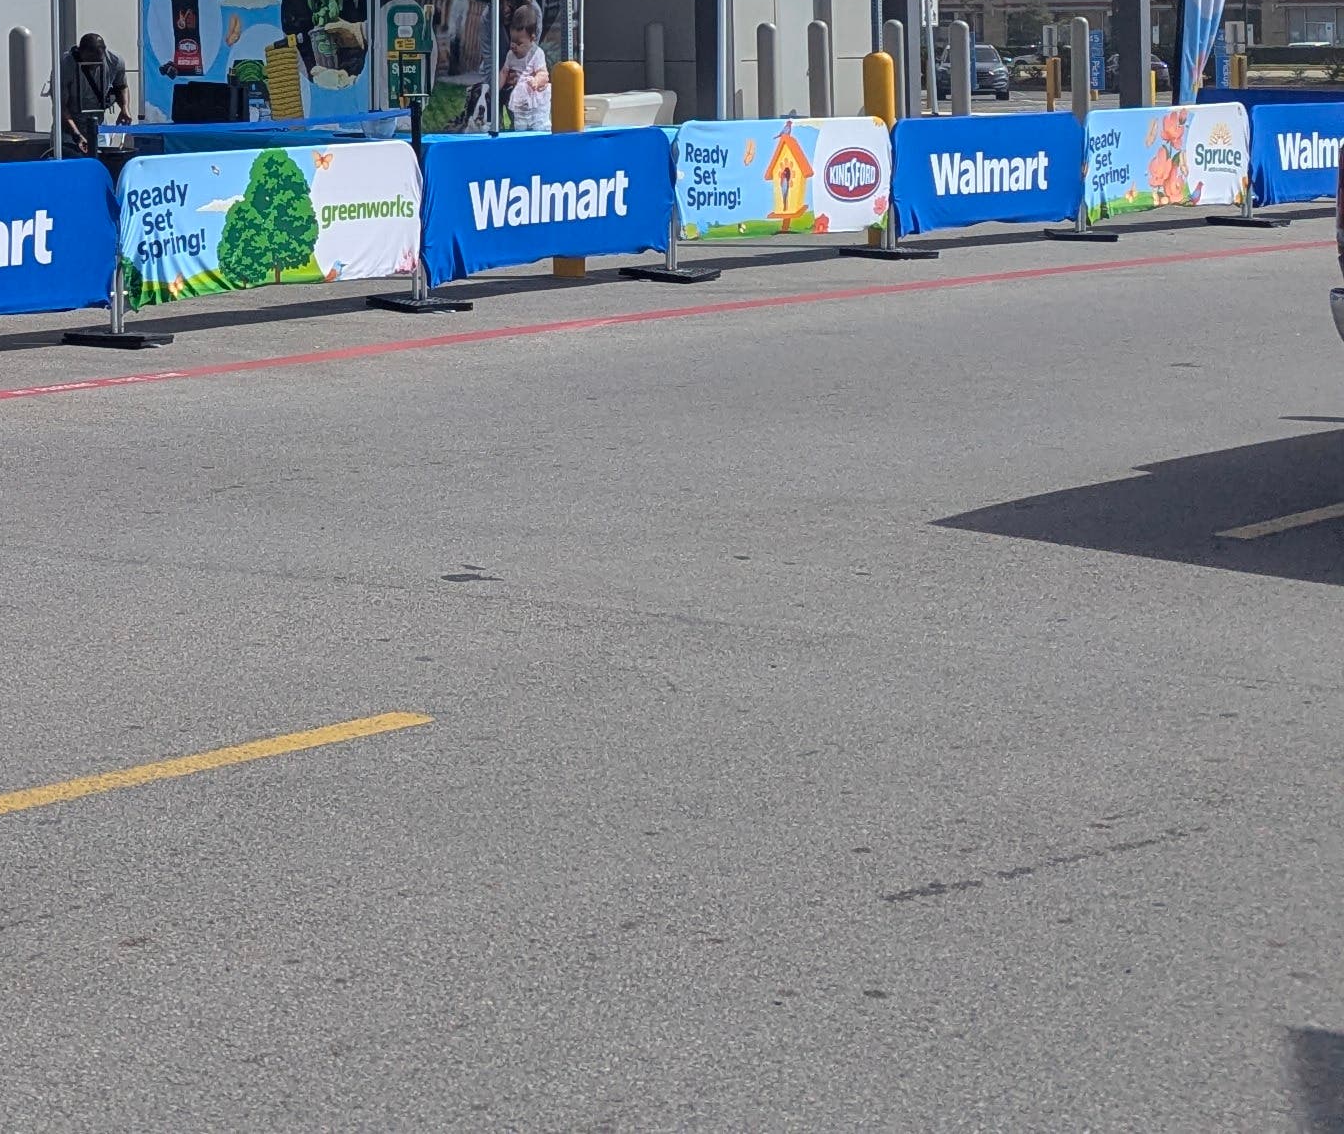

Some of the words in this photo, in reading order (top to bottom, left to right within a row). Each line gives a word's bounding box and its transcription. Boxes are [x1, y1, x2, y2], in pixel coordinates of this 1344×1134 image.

[684, 143, 729, 168] Ready
[1090, 129, 1121, 154] Ready
[1277, 131, 1344, 171] Walm
[1095, 150, 1112, 171] Set
[1194, 143, 1242, 171] Spruce
[693, 166, 718, 186] Set
[829, 157, 876, 192] KINGSFORD
[930, 150, 1049, 196] Walmart
[1092, 164, 1130, 193] Spring!
[126, 179, 189, 216] Ready
[321, 195, 414, 229] greenworks
[468, 170, 629, 232] Walmart
[686, 186, 742, 211] Spring!
[142, 208, 174, 236] Set
[136, 228, 206, 265] Spring!
